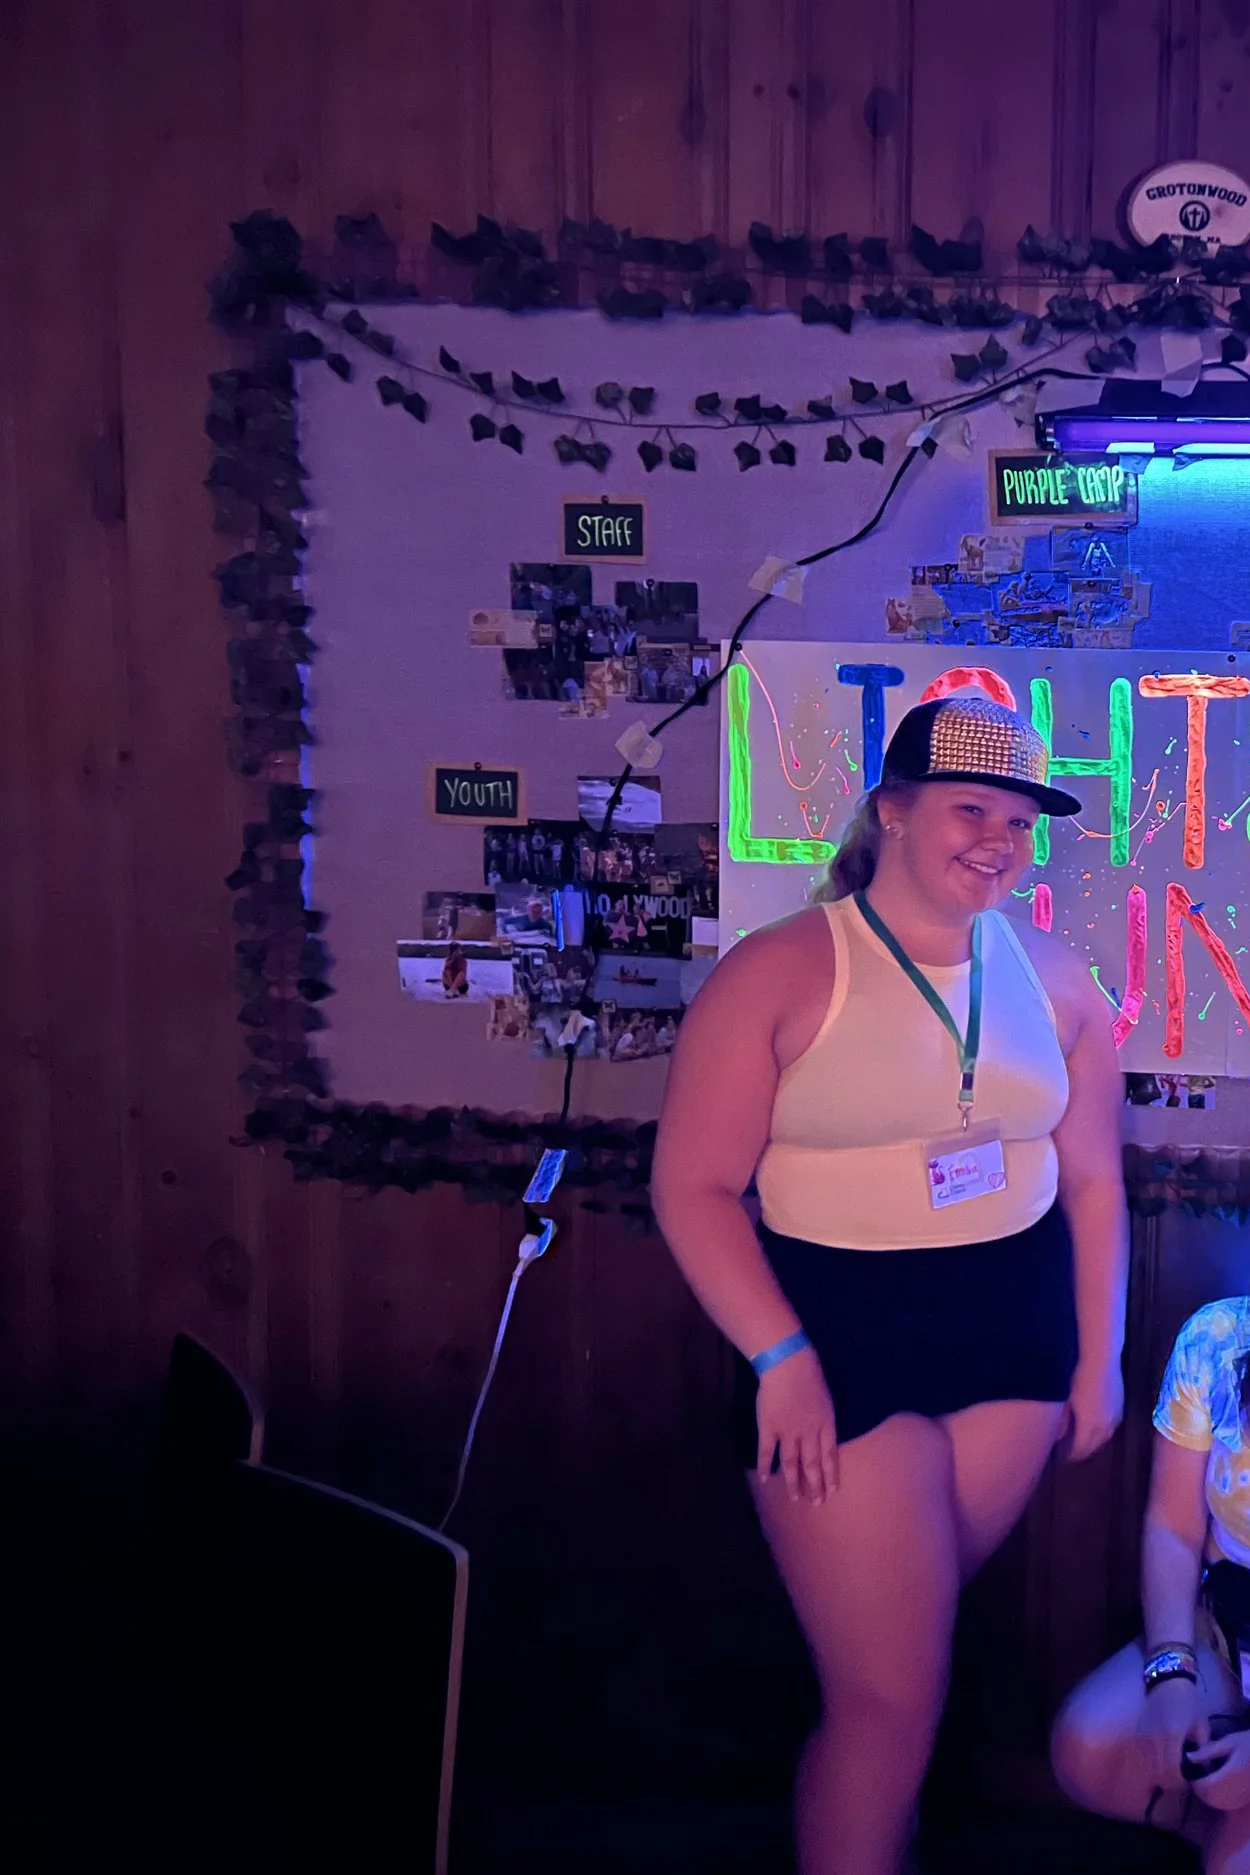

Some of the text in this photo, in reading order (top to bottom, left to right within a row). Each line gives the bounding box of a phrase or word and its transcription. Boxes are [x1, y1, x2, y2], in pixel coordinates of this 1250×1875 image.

[1146, 183, 1247, 206] GROTONWOOD
[1003, 465, 1124, 505] PURPLE CAMP
[577, 515, 633, 547] STAFF
[444, 778, 512, 810] YOUTH
